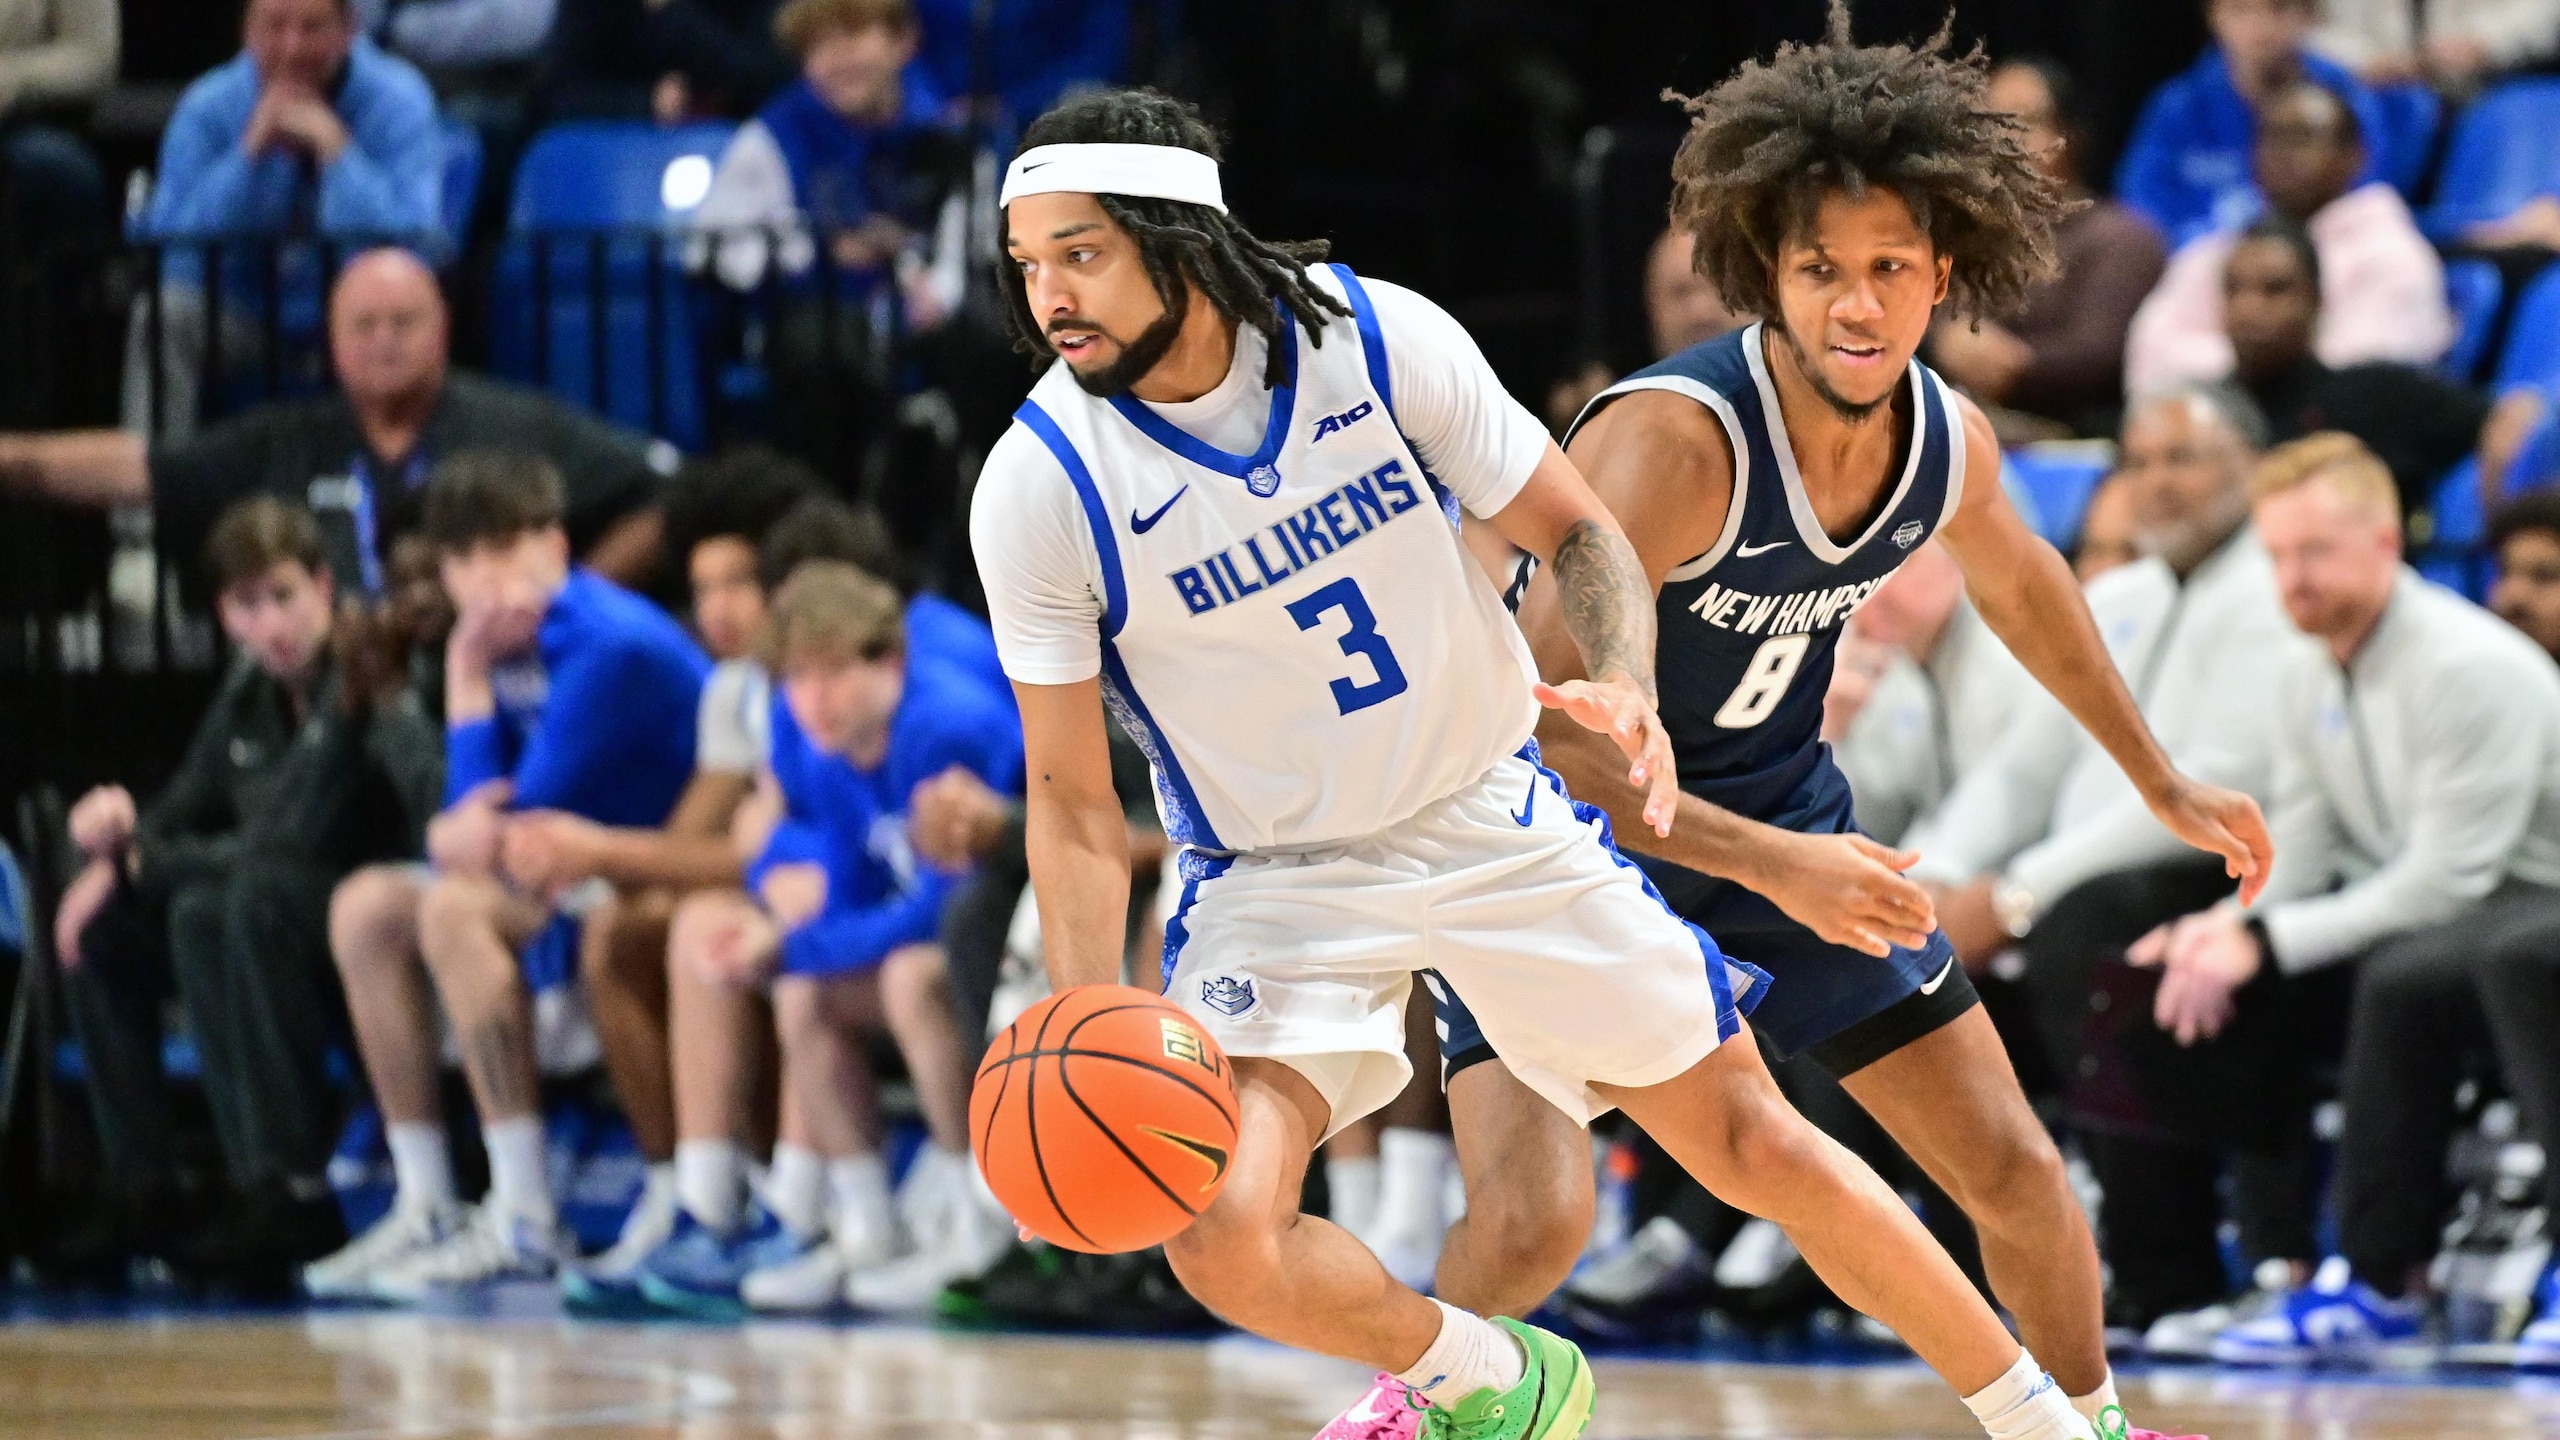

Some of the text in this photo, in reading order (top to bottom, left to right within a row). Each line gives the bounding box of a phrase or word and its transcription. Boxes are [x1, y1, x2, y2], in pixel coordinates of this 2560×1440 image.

[1312, 400, 1374, 444] A10
[1165, 457, 1424, 618] BILLIKENS
[1283, 577, 1408, 717] 3
[1688, 582, 1781, 635] NEW
[1713, 632, 1811, 729] 8
